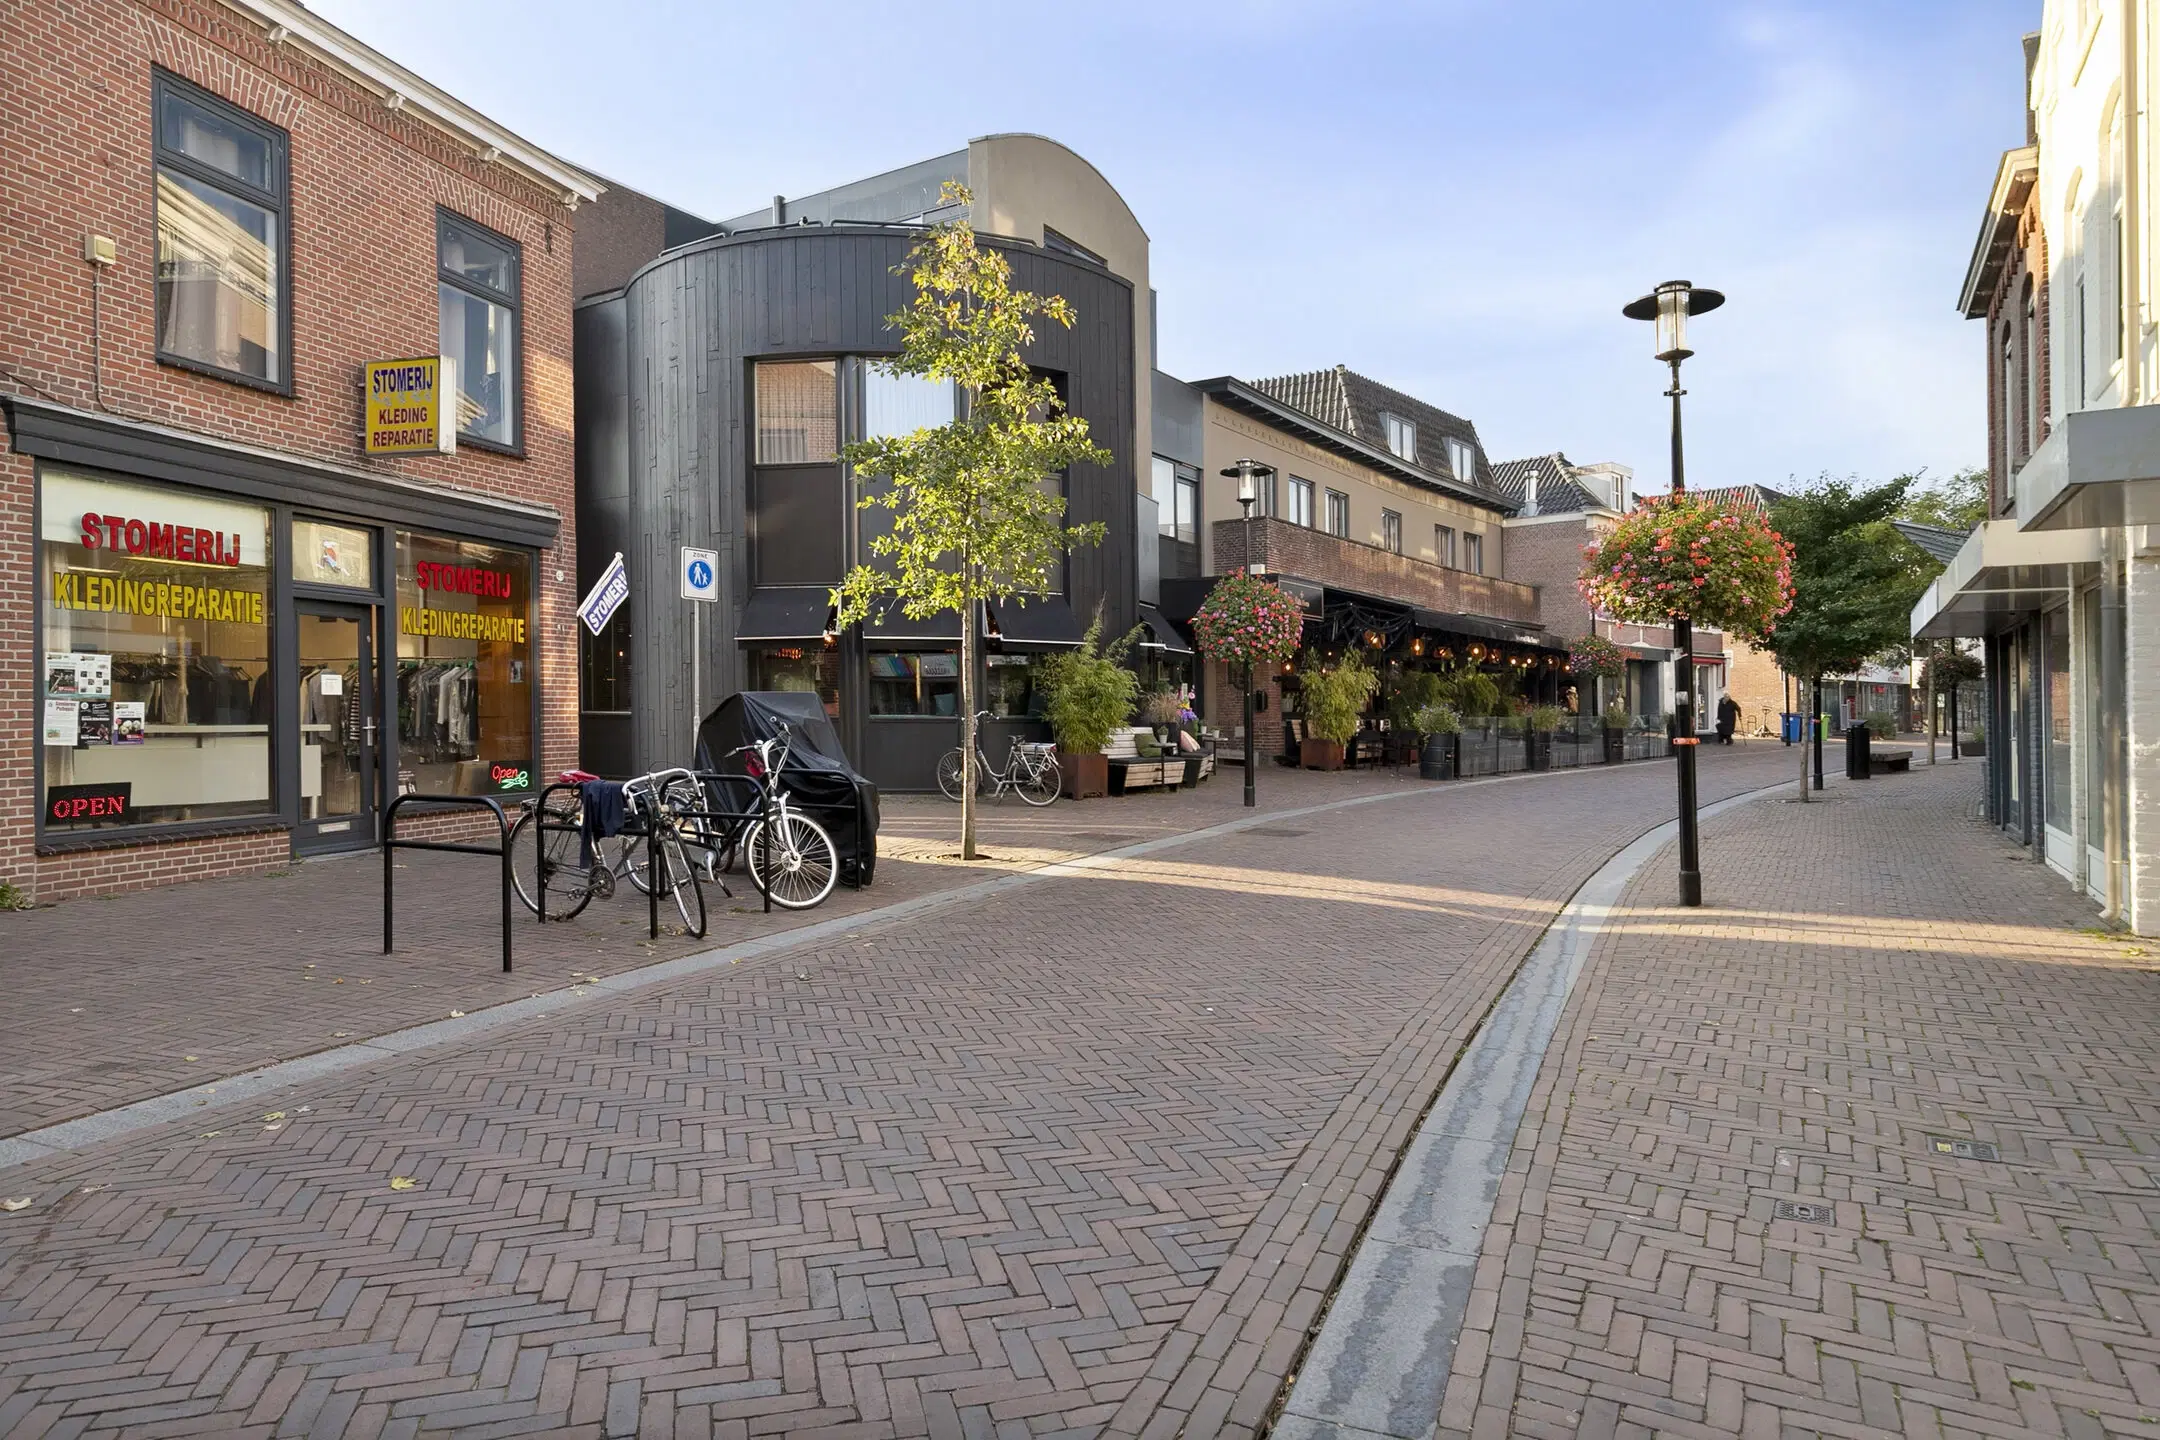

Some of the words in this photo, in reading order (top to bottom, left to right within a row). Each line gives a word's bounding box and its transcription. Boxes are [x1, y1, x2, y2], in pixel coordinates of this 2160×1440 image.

[373, 365, 433, 393] STOMERIJ
[379, 407, 428, 424] KLEDING
[373, 428, 433, 447] REPARATIE
[80, 512, 241, 567] STOMERIJ
[692, 551, 708, 560] ZONE
[416, 560, 511, 599] STOMERIJ
[54, 572, 264, 625] KLEDINGREPARATIE
[401, 606, 525, 643] KLEDINGREPARATIE
[492, 764, 518, 784] Open
[53, 796, 125, 818] OPEN
